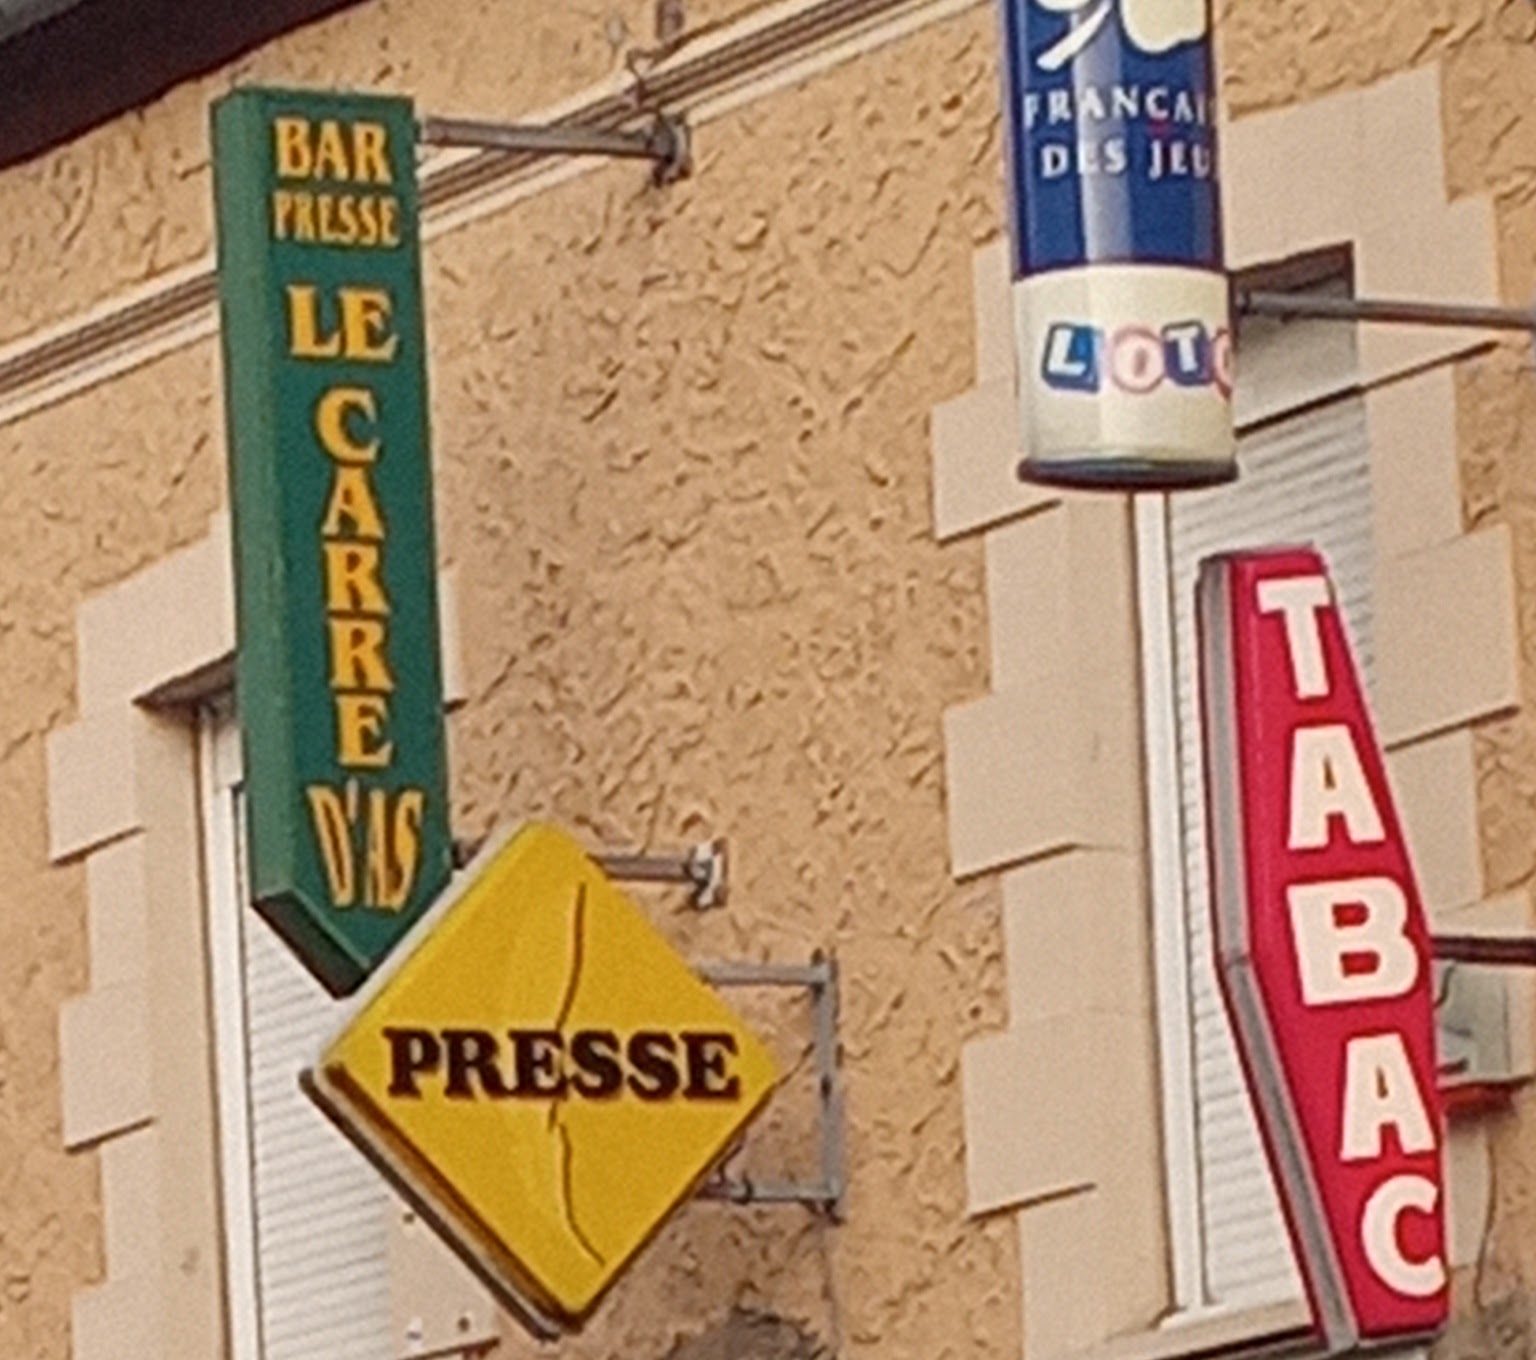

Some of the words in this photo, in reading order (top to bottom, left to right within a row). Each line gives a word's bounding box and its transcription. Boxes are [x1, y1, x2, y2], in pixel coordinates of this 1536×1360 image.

[274, 117, 391, 185] BAR
[1041, 138, 1128, 179] DES
[274, 193, 401, 248] PRESSE
[286, 285, 398, 361] LE
[314, 388, 394, 767] CARRE
[1255, 574, 1448, 1298] TABAC
[382, 1026, 741, 1101] PRESSE
